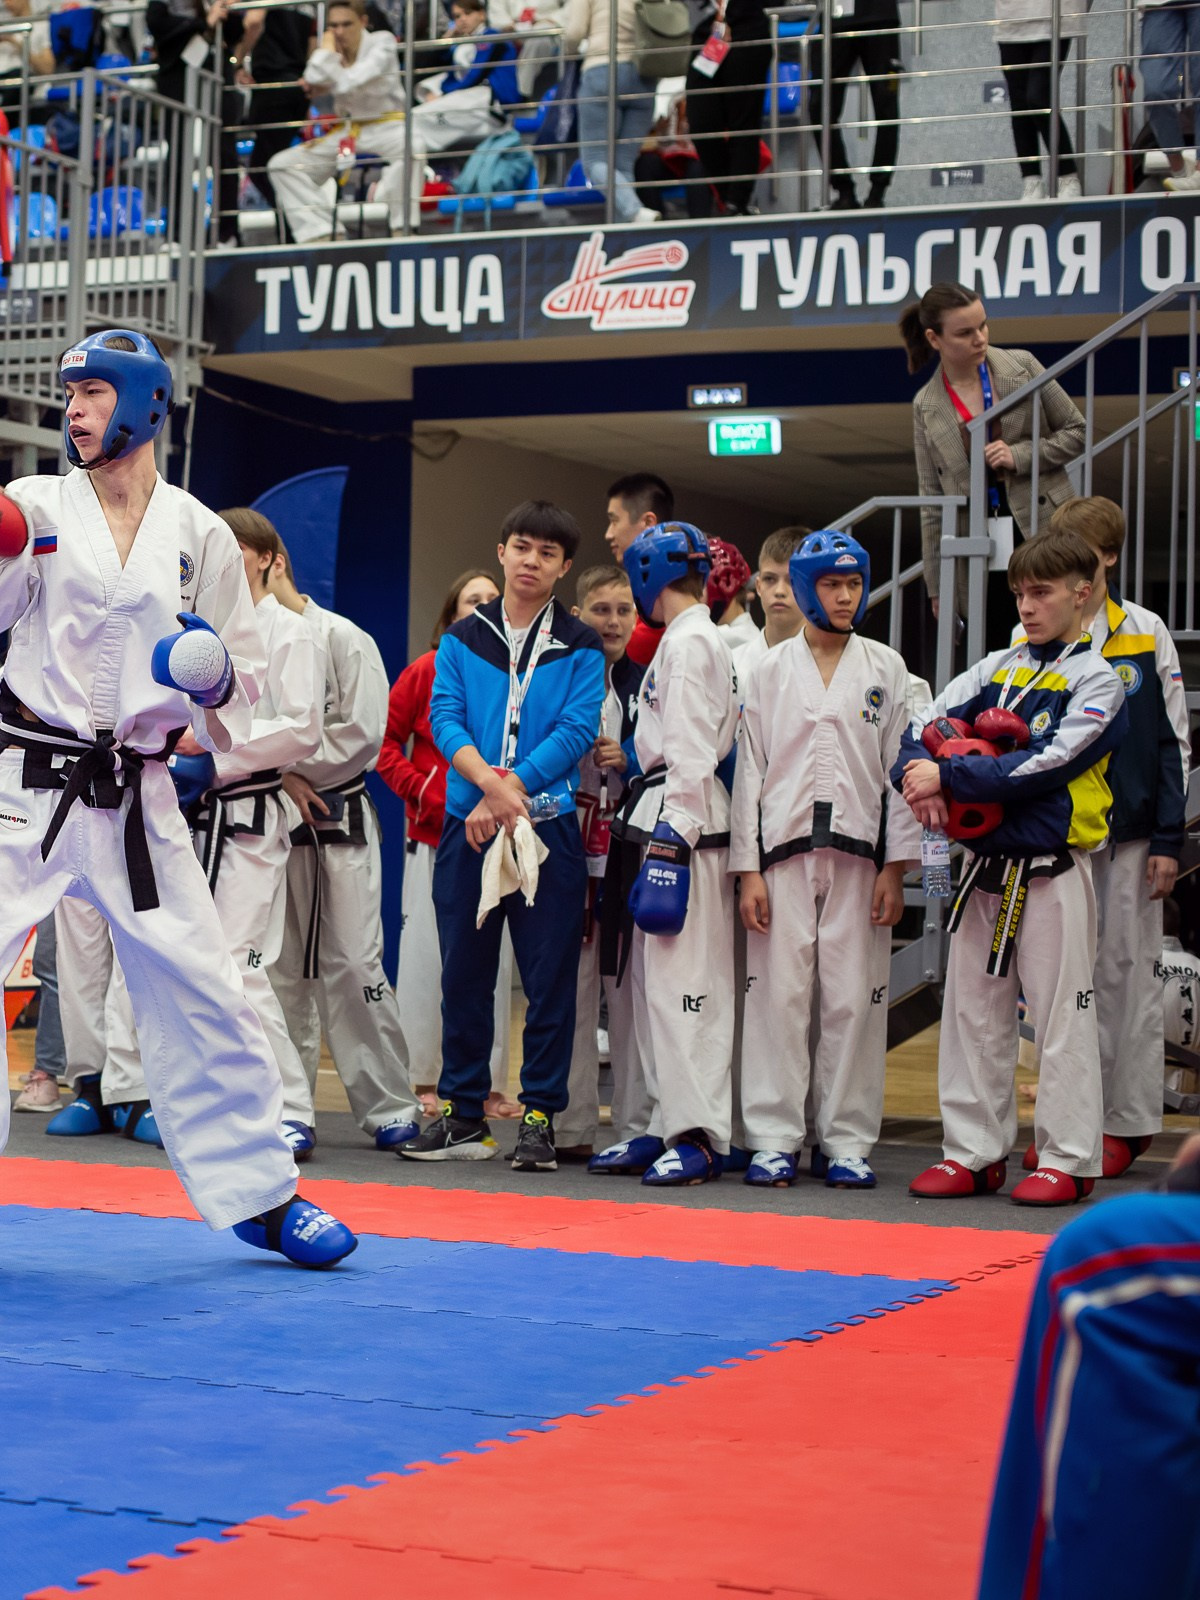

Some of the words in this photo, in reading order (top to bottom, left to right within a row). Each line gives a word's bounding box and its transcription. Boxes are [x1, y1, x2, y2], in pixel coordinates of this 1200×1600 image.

[990, 87, 1005, 103] 2
[256, 253, 505, 334] ТУЛИЦА
[731, 221, 1101, 311] ТУЛЬСКАЯ
[1141, 216, 1200, 293] О
[991, 908, 1008, 953] KRAVTSOV
[1000, 865, 1018, 911] ALEKSANDR
